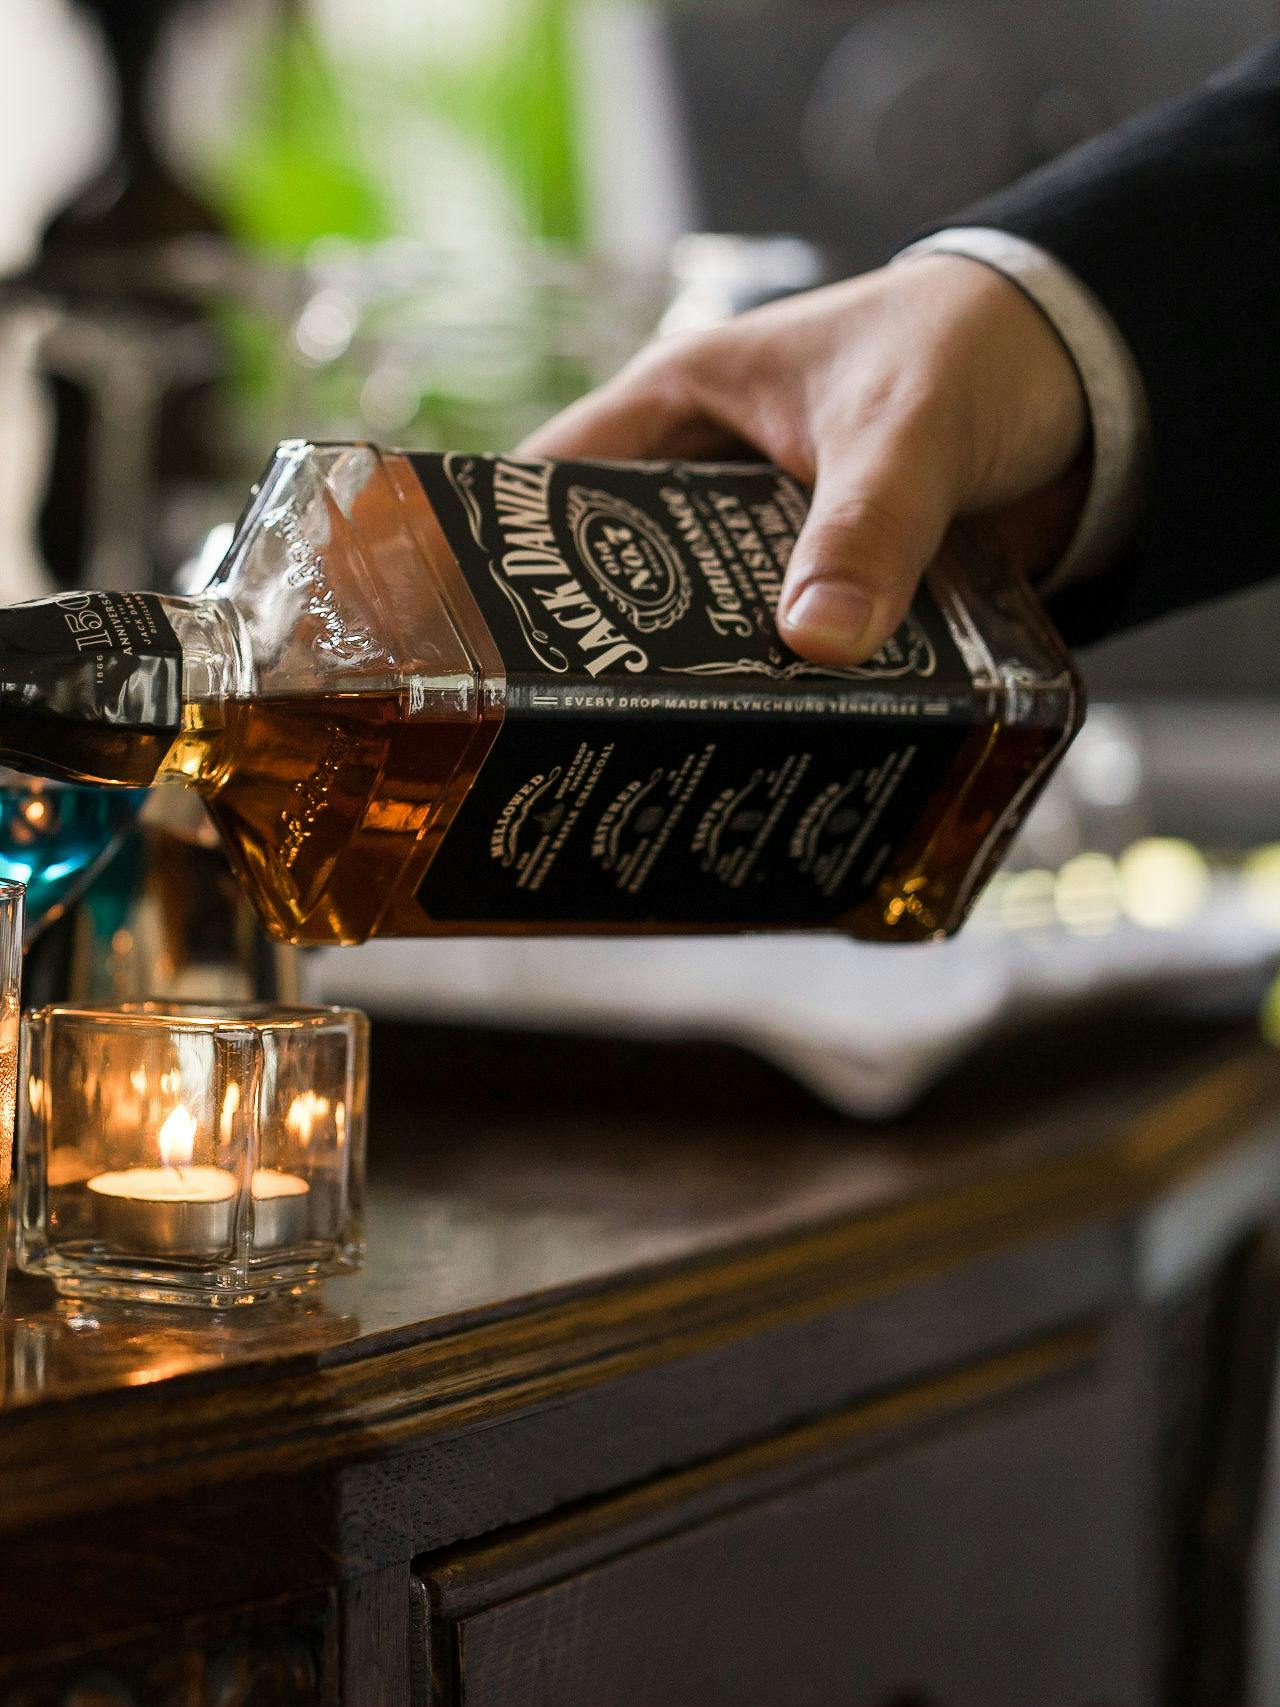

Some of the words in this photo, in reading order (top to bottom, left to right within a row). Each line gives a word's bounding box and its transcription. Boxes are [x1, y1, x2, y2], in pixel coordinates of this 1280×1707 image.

[494, 461, 571, 576] DANIEL
[708, 491, 784, 613] HISKEY
[98, 592, 133, 656] ANNIVERSA
[135, 619, 152, 646] JACK
[531, 578, 648, 678] JACK
[565, 696, 615, 708] EVERY
[619, 697, 660, 709] DROP
[664, 698, 707, 710] MADE
[712, 699, 728, 710] IN
